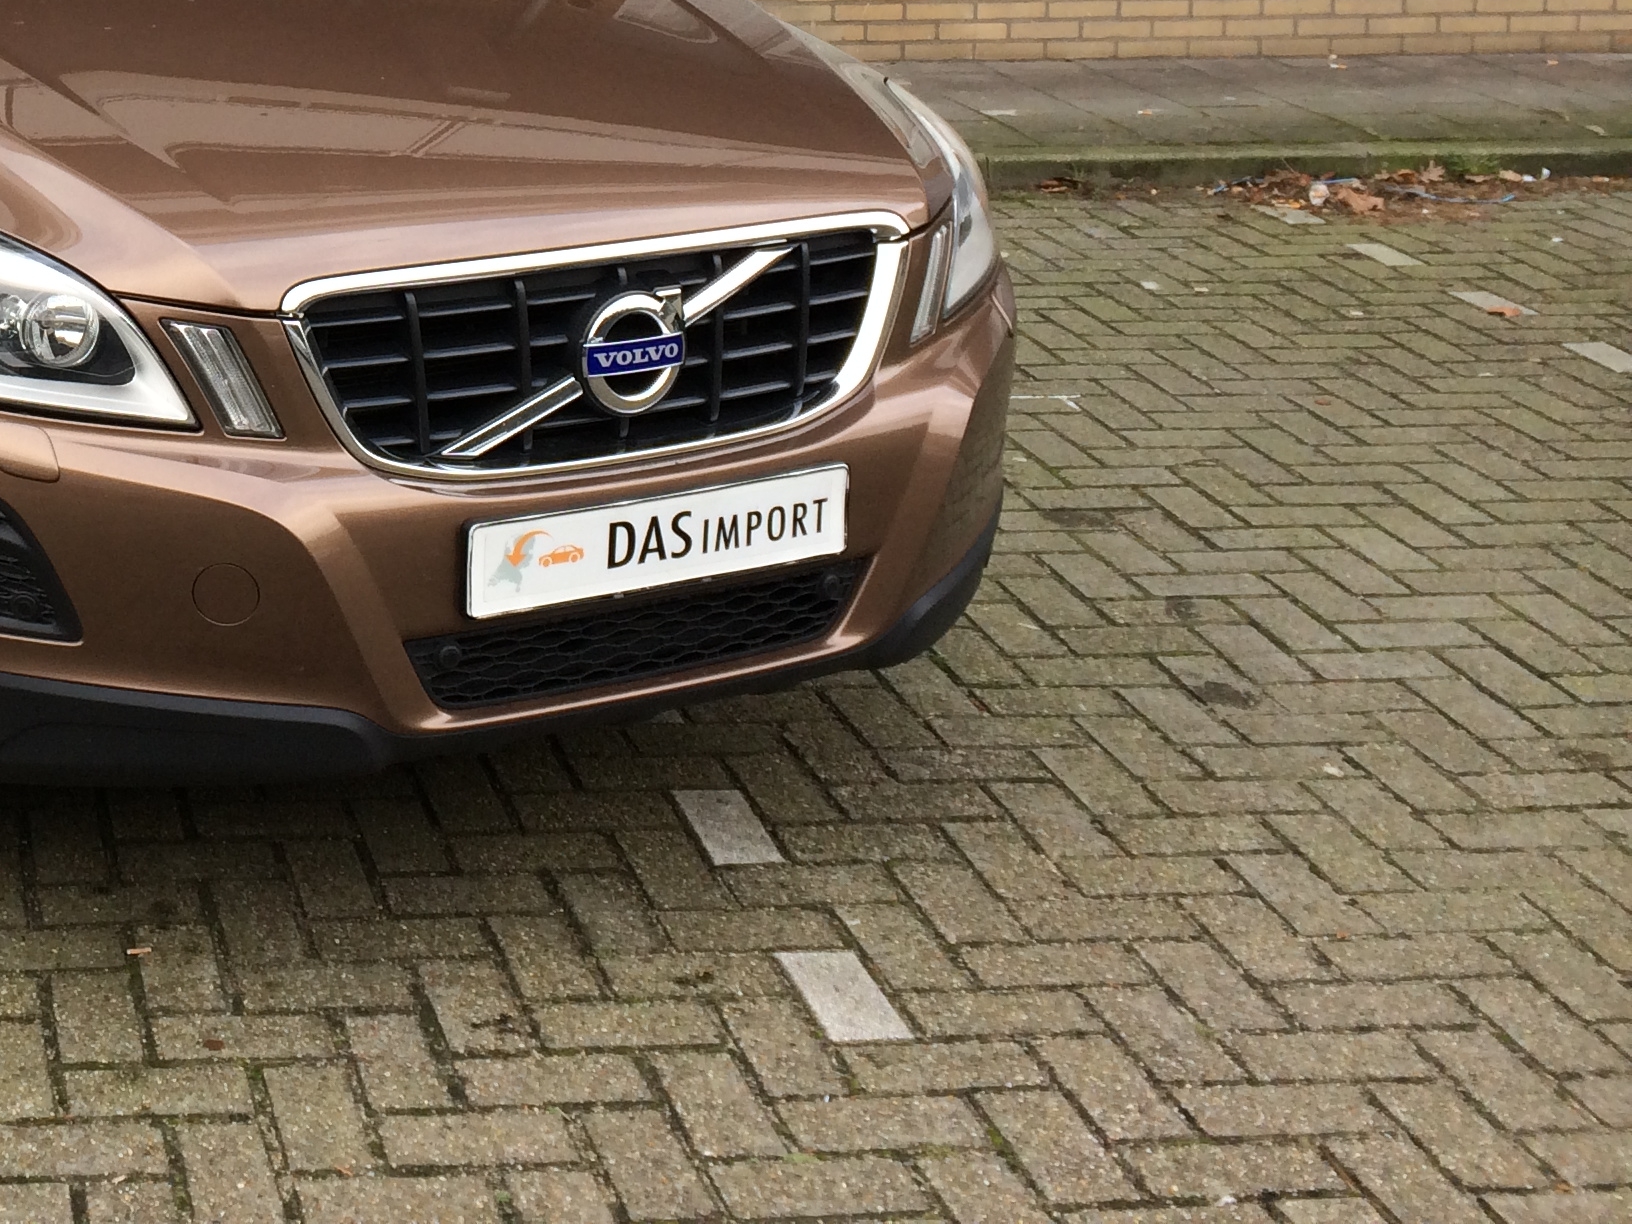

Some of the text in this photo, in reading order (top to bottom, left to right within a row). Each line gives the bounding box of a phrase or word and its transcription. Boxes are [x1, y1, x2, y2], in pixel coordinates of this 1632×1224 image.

[594, 342, 679, 368] VOLVO
[606, 497, 829, 570] DAS IMPORT
